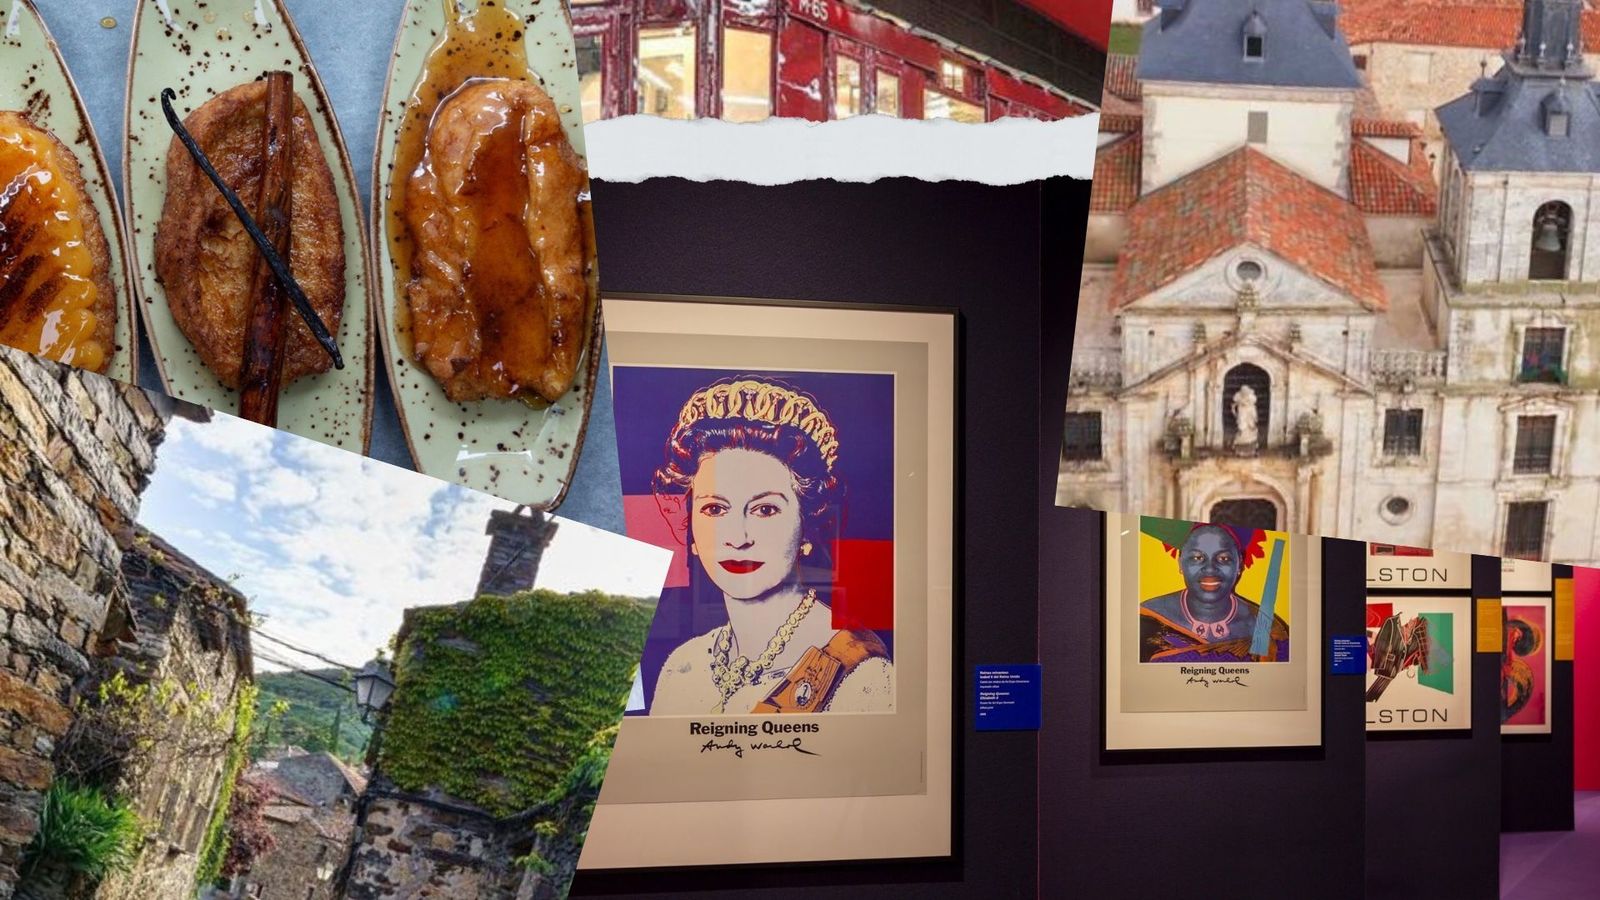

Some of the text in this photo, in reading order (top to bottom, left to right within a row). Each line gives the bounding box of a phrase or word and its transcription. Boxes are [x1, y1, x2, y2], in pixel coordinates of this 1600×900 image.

[1180, 666, 1250, 676] Reigning Queens
[690, 720, 820, 737] Reigning Queens
[700, 739, 744, 758] Andy
